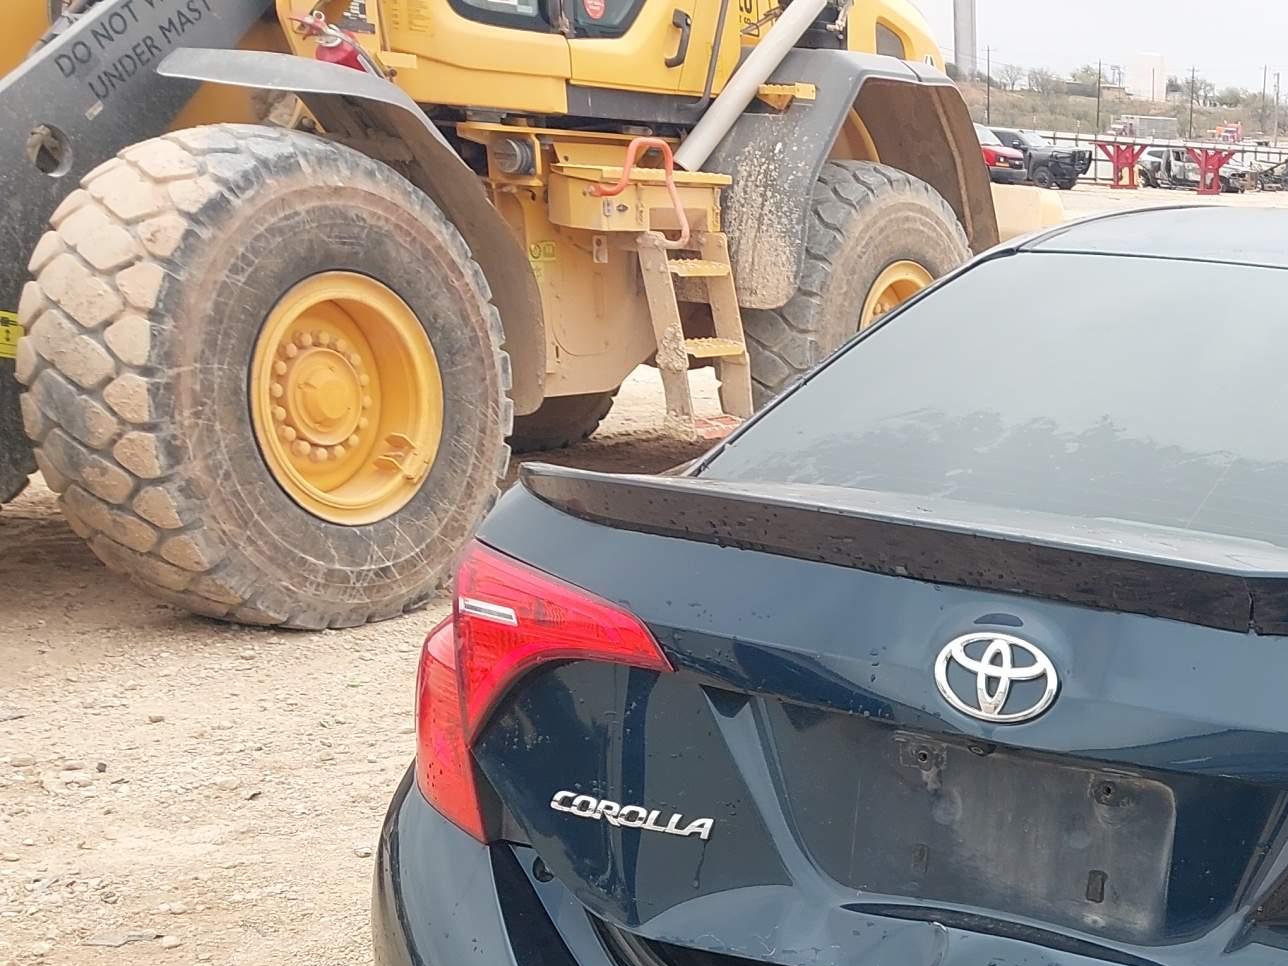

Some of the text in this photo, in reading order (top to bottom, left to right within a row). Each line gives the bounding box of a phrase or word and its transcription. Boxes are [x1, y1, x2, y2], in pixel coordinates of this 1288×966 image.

[54, 0, 139, 78] DO NOT
[88, 35, 162, 99] UNDER
[550, 790, 714, 840] COROLLA
